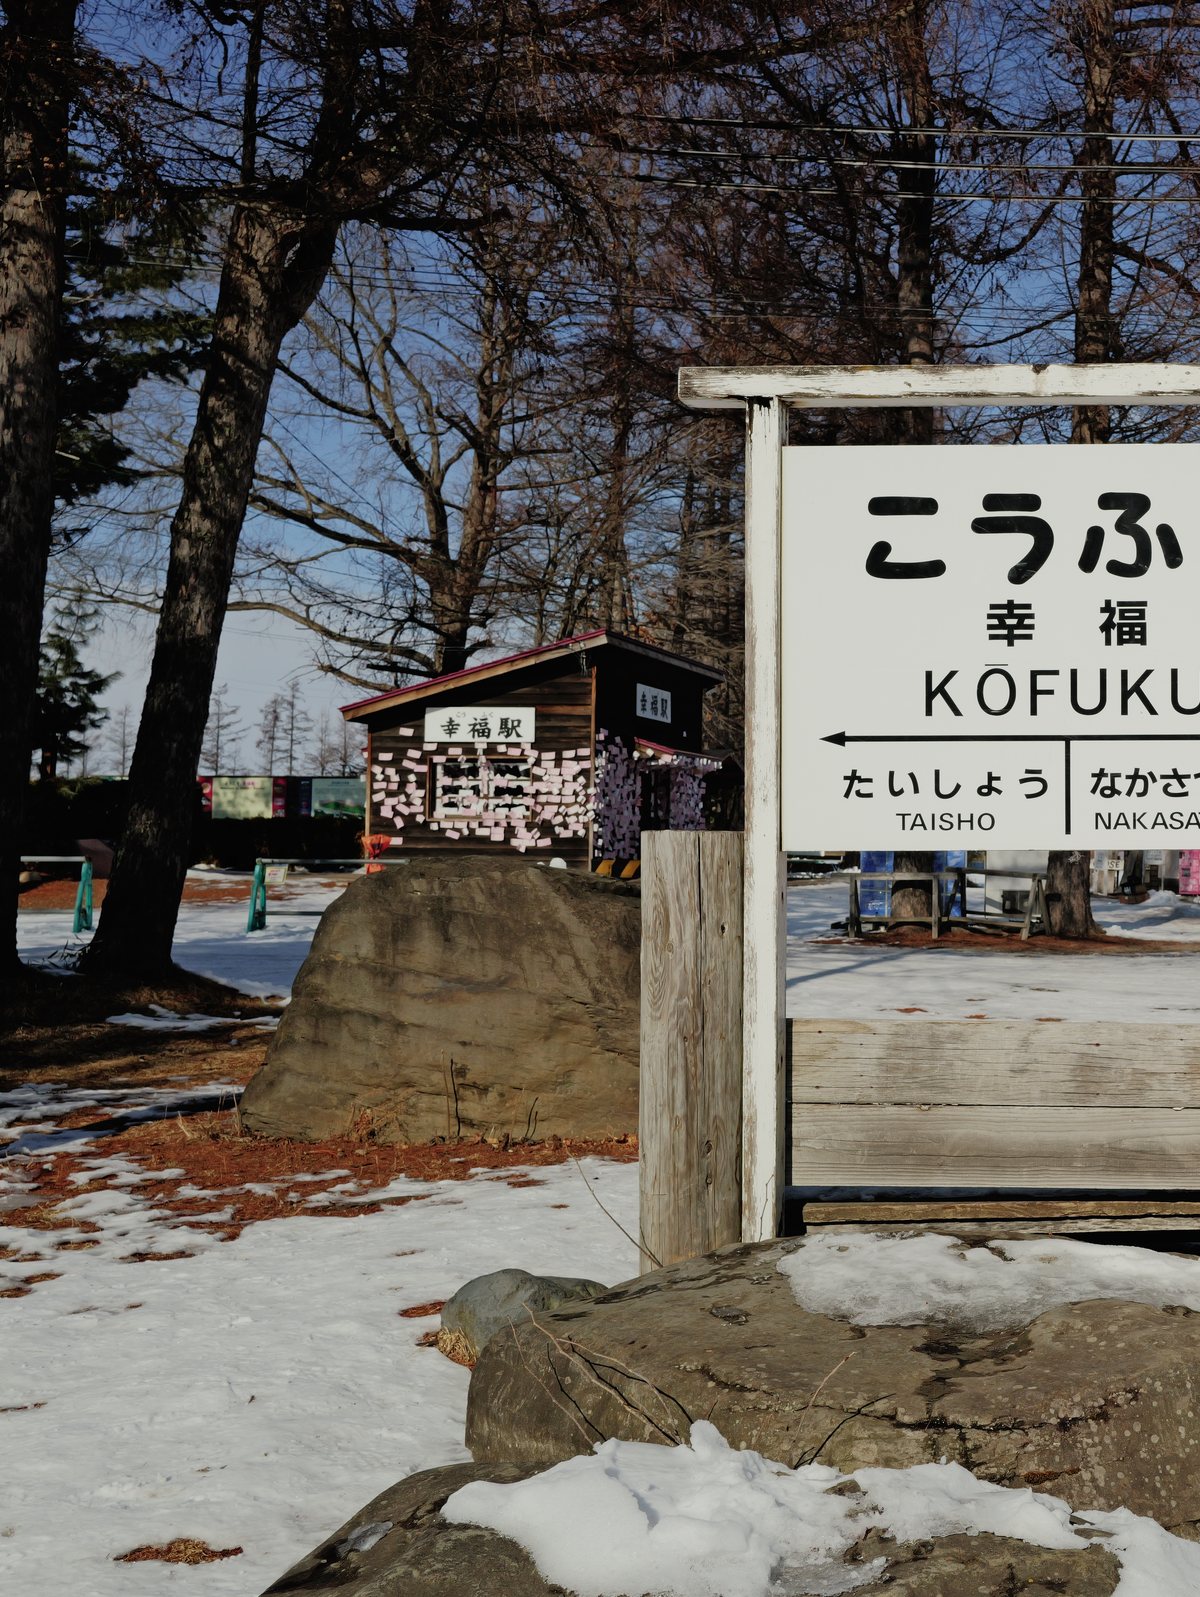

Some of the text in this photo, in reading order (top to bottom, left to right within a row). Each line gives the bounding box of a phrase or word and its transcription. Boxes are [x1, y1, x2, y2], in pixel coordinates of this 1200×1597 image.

[986, 598, 1149, 647] 幸福
[640, 691, 668, 720] 幸福駅
[440, 717, 523, 740] 幸福駅
[841, 768, 1049, 800] たいしょう
[896, 811, 996, 831] TAISHO
